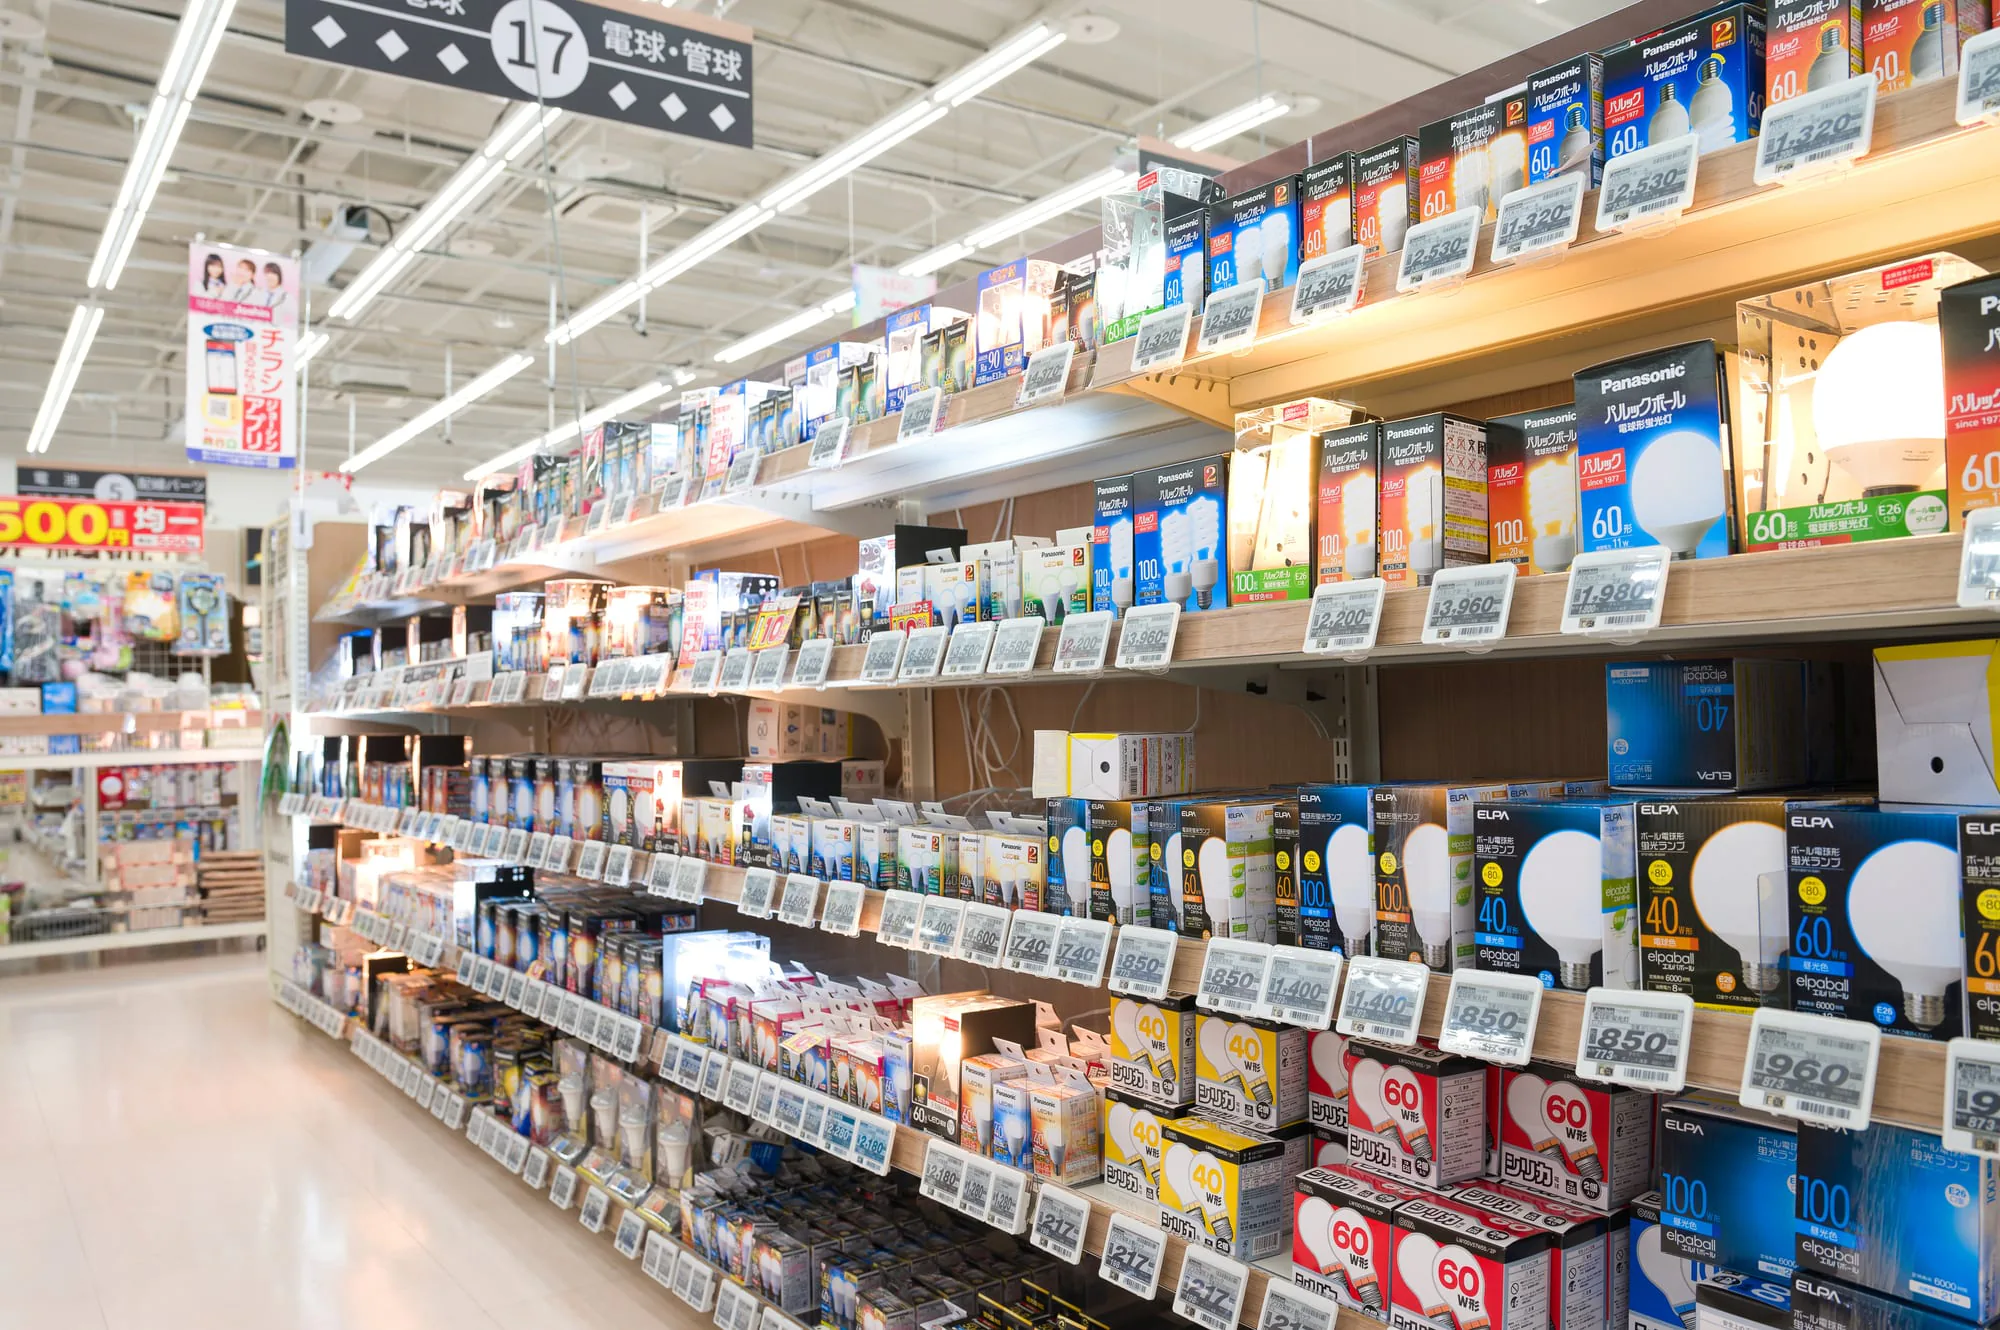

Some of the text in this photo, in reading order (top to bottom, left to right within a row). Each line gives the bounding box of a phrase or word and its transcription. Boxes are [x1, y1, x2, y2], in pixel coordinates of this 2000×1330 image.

[1715, 20, 1733, 43] 2
[507, 19, 573, 75] 17
[601, 20, 743, 81] 電球・管球
[1643, 30, 1698, 59] Panasonic
[1532, 66, 1581, 90] Panasonic
[1871, 50, 1898, 84] 60
[1533, 82, 1580, 108] パルックボール
[1771, 70, 1797, 103] 60
[1607, 92, 1642, 114] パルック
[1450, 108, 1496, 132] Panasonic
[1611, 125, 1636, 157] 60
[1776, 112, 1849, 151] 1,320
[1360, 145, 1400, 167] Panasonic
[1532, 146, 1551, 174] 60
[1306, 161, 1344, 182] Panasonic
[1617, 167, 1679, 198] 2,530
[1232, 191, 1267, 209] Panasonic
[1276, 184, 1288, 201] 2
[1423, 190, 1446, 217] 60
[1168, 217, 1199, 235] Panasonic
[1360, 216, 1376, 240] 60
[1508, 204, 1564, 235] 1,320
[1306, 229, 1321, 254] 60
[1410, 237, 1462, 265] 2,530
[1213, 260, 1230, 284] 60
[1166, 279, 1179, 302] 60
[261, 329, 284, 394] チラシ
[988, 350, 1001, 370] 90
[1601, 364, 1685, 395] Panasonic
[1604, 390, 1686, 424] パルックボール
[245, 397, 265, 450] アプリ
[1387, 423, 1434, 440] Panasonic
[1524, 411, 1577, 430] Panasonic
[1955, 417, 1979, 430] since
[1324, 434, 1369, 449] Panasonic
[1205, 465, 1217, 483] 2
[1582, 453, 1621, 475] パルック
[1961, 451, 2000, 493] 60
[1158, 469, 1194, 484] Panasonic
[1587, 474, 1620, 487] since 1977
[109, 483, 122, 500] 5
[1097, 483, 1128, 496] Panasonic
[134, 506, 199, 533] 均一
[1808, 501, 1868, 519] パルックボール
[1878, 503, 1901, 517] E26
[1495, 518, 1523, 545] 100
[1592, 505, 1622, 539] 60
[1753, 511, 1787, 542] 60
[1320, 534, 1339, 557] 100
[1382, 528, 1403, 553] 100
[1094, 568, 1108, 588] 100
[1138, 559, 1158, 581] 100
[1235, 572, 1254, 593] 100
[1442, 598, 1493, 620] 3,960
[1320, 608, 1365, 633] 2,200
[1697, 697, 1729, 732] 40
[1697, 771, 1731, 781] ELPA
[1300, 794, 1322, 803] ELPA
[1375, 793, 1398, 802] ELPA
[1449, 793, 1469, 802] ELPA
[1510, 789, 1529, 798] ELPA
[1567, 785, 1584, 794] ELPA
[1091, 803, 1105, 811] ELPA
[1181, 810, 1196, 818] ELPA
[1274, 811, 1291, 819] ELPA
[1477, 809, 1510, 821] ELPA
[1604, 812, 1622, 823] ELPA
[1641, 804, 1679, 816] ELPA
[1791, 816, 1834, 829] ELPA
[1641, 832, 1685, 843] ボール電球形
[1790, 846, 1840, 858] ボール電球形
[1092, 864, 1104, 882] 40
[1183, 874, 1197, 893] 60
[1486, 870, 1498, 880] 80
[1655, 868, 1667, 878] 80
[1276, 876, 1292, 899] 60
[1301, 879, 1325, 907] 100
[1377, 882, 1403, 912] 100
[1806, 885, 1820, 896] 80
[1303, 917, 1331, 929] elpaball
[1479, 896, 1507, 933] 40
[1646, 895, 1679, 935] 40
[1379, 922, 1408, 934] elpaball
[1795, 916, 1832, 958] 60
[1063, 943, 1095, 962] 740
[1123, 953, 1160, 973] 850
[1479, 948, 1520, 963] elpaball
[1647, 950, 1695, 966] elpaball
[1211, 967, 1255, 989] 850
[1274, 977, 1323, 1000] 1,400
[1665, 974, 1682, 983] 6000
[1796, 976, 1849, 993] elpaball
[1355, 988, 1408, 1014] 1,400
[1815, 1002, 1835, 1012] 6000
[1876, 1006, 1893, 1016] E26
[1139, 1015, 1166, 1038] 40
[1458, 1005, 1519, 1031] 850
[1229, 1035, 1261, 1060] 40
[1597, 1027, 1668, 1053] 850
[1593, 1048, 1613, 1060] 773
[1112, 1061, 1145, 1089] シリカ
[1244, 1060, 1261, 1073] W形
[1768, 1053, 1849, 1086] 960
[1762, 1076, 1785, 1088] 873
[995, 1089, 1017, 1101] Panasonic
[1033, 1096, 1056, 1108] Panasonic
[1198, 1084, 1236, 1112] シリカ
[1384, 1078, 1419, 1111] 60
[913, 1106, 925, 1122] 60
[962, 1107, 972, 1125] 60
[1401, 1109, 1419, 1124] W形
[1547, 1094, 1587, 1128] 60
[1133, 1120, 1159, 1144] 40
[1565, 1127, 1587, 1142] W形
[1665, 1119, 1704, 1136] ELPA
[1968, 1117, 1993, 1130] 873
[857, 1133, 884, 1154] 2,180
[1350, 1133, 1391, 1166] シリカ
[929, 1163, 956, 1184] 2,180
[1107, 1164, 1139, 1194] シリカ
[1192, 1165, 1222, 1194] 40
[1504, 1152, 1553, 1188] シリカ
[1206, 1193, 1222, 1206] W形
[1663, 1172, 1707, 1219] 100
[1798, 1175, 1850, 1229] 100
[1044, 1211, 1076, 1238] 217
[1332, 1220, 1369, 1256] 60
[1666, 1229, 1716, 1253] elpaball
[1115, 1240, 1150, 1270] 217
[1349, 1253, 1369, 1270] W形
[1802, 1239, 1860, 1265] elpaball
[1438, 1259, 1480, 1297] 60
[1795, 1278, 1842, 1305] ELPA
[1457, 1294, 1480, 1312] W形
